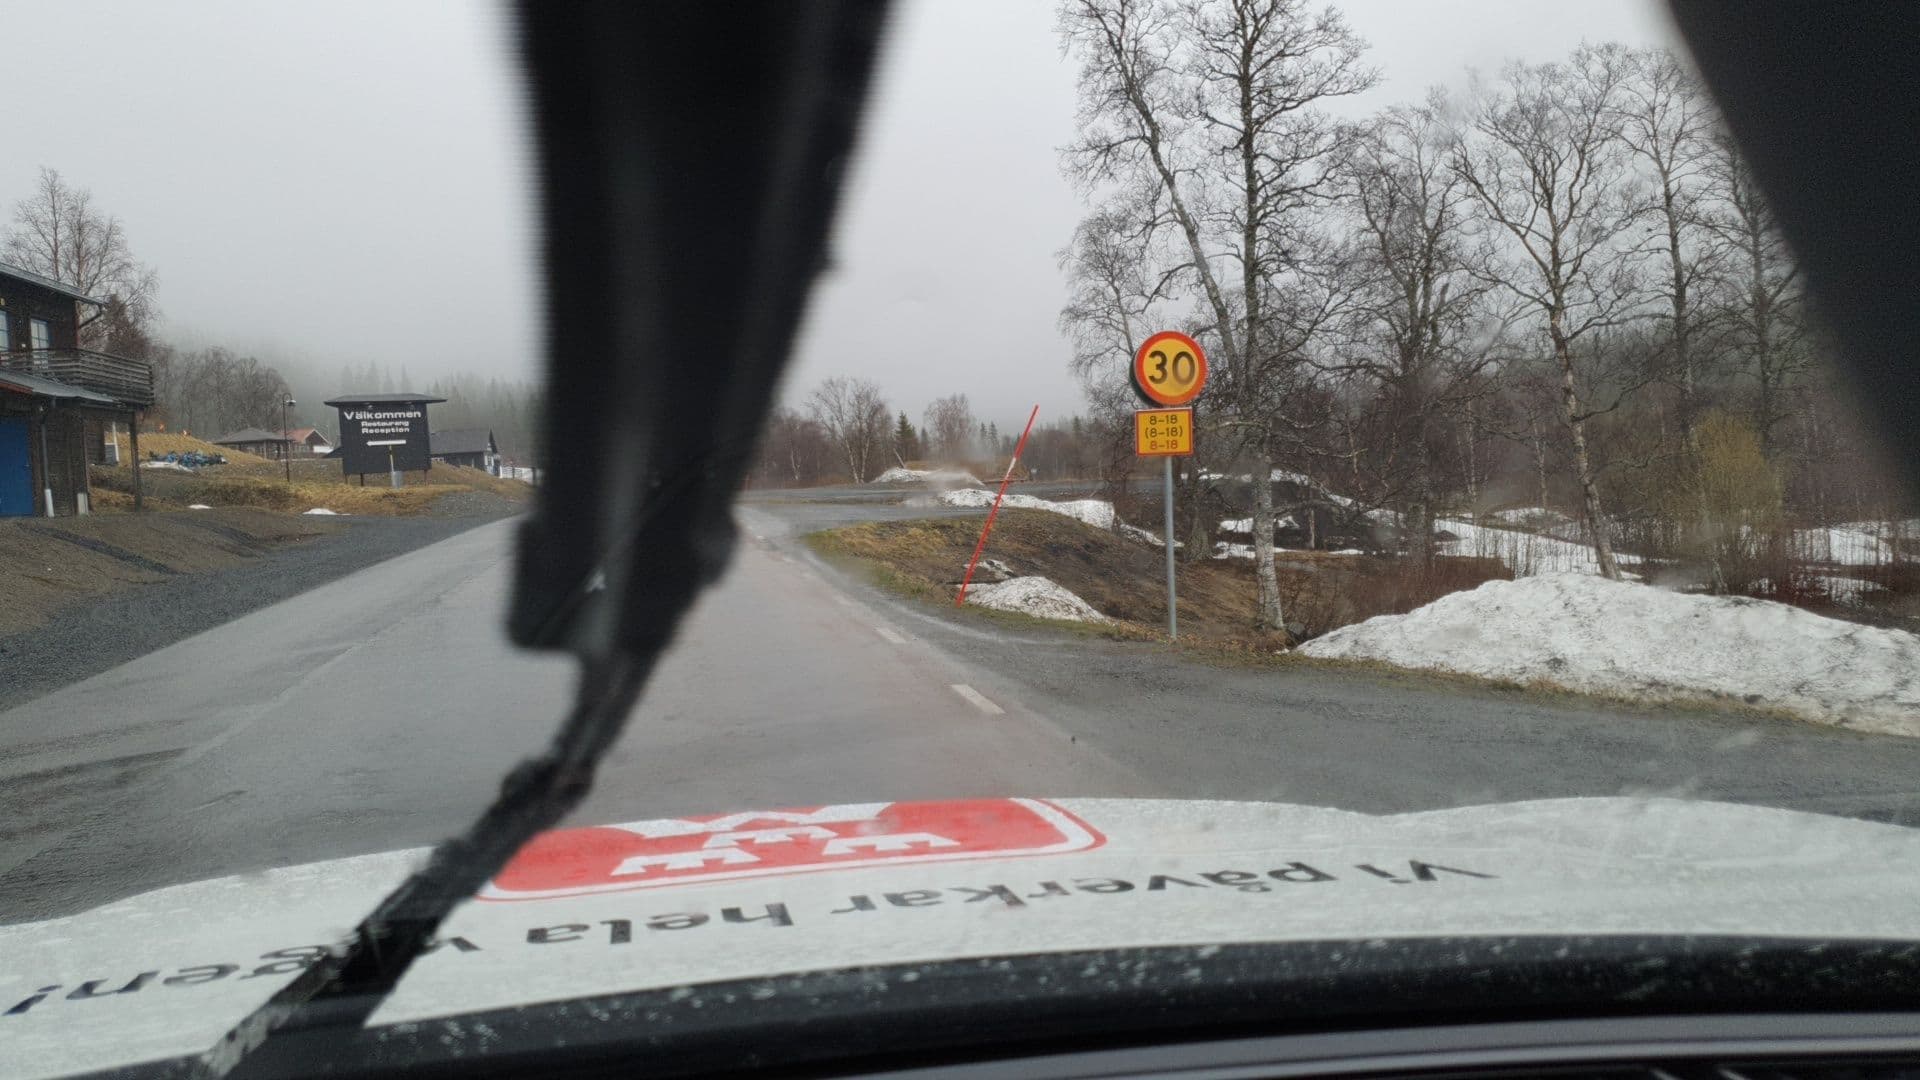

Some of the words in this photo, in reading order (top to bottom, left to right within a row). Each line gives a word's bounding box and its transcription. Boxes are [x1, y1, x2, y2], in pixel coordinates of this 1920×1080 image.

[1148, 350, 1196, 386] 30
[343, 410, 422, 420] Välkommen
[1149, 414, 1178, 425] 8-18
[1144, 426, 1183, 439] (8-18)
[1149, 440, 1178, 450] 8-18
[1354, 859, 1501, 884] Vi
[830, 861, 1339, 914] påverkar
[526, 902, 794, 945] hela
